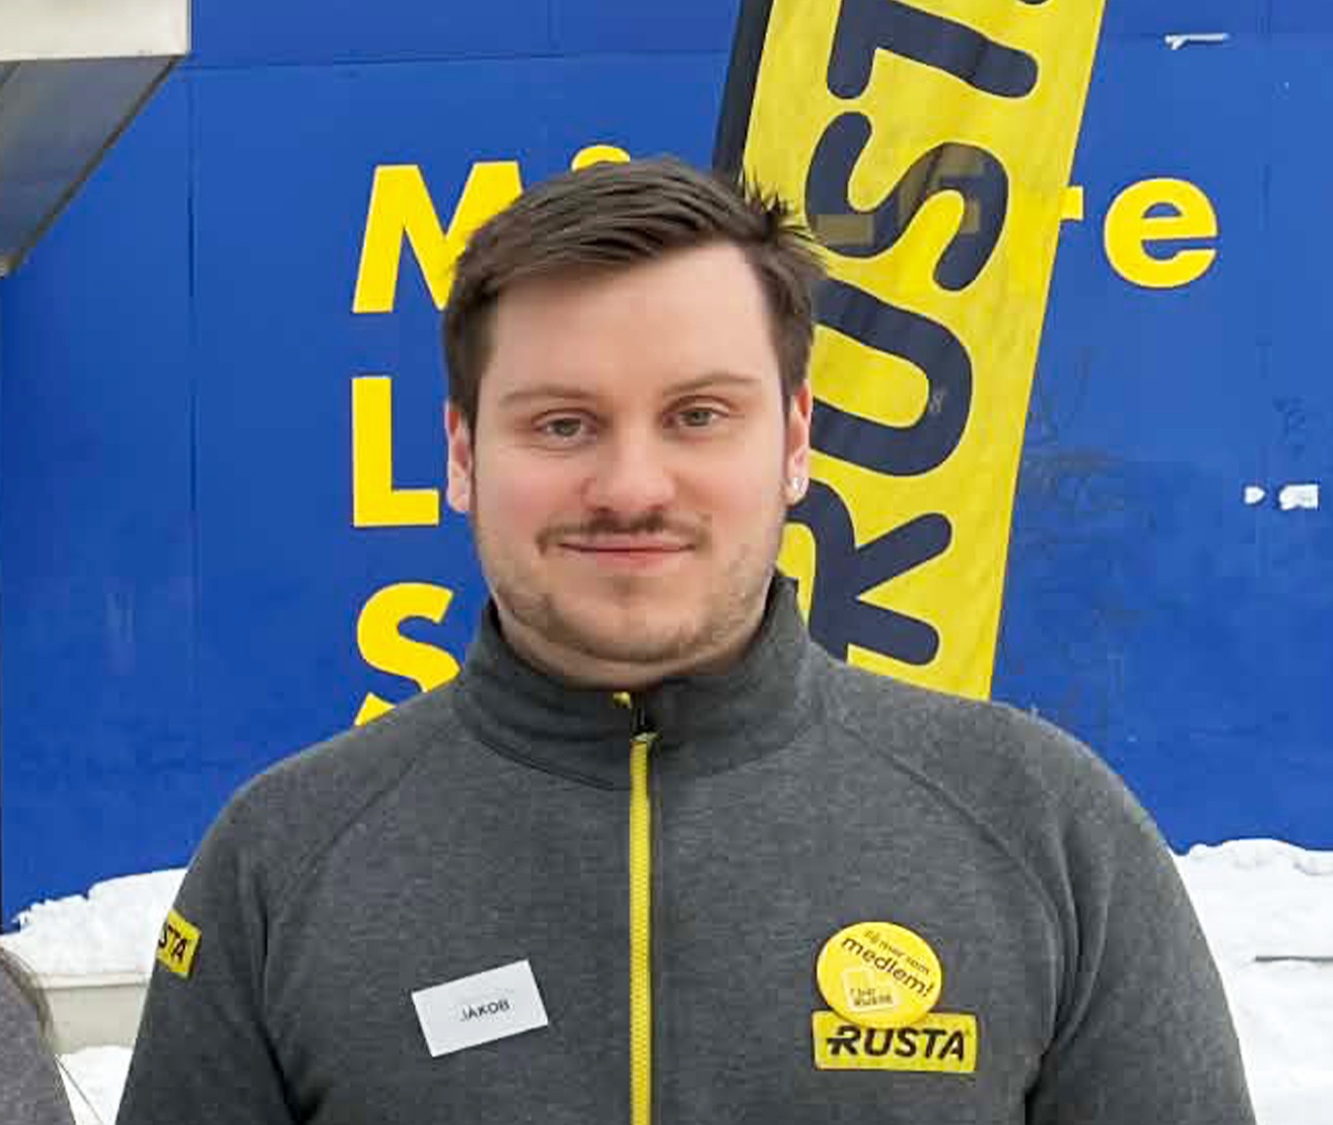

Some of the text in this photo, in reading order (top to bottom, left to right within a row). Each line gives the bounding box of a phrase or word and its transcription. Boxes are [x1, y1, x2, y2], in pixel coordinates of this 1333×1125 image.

[785, 0, 1041, 667] RUST
[841, 937, 934, 998] medlem!
[460, 999, 511, 1021] JAKOB
[827, 1025, 965, 1061] RUSTA
